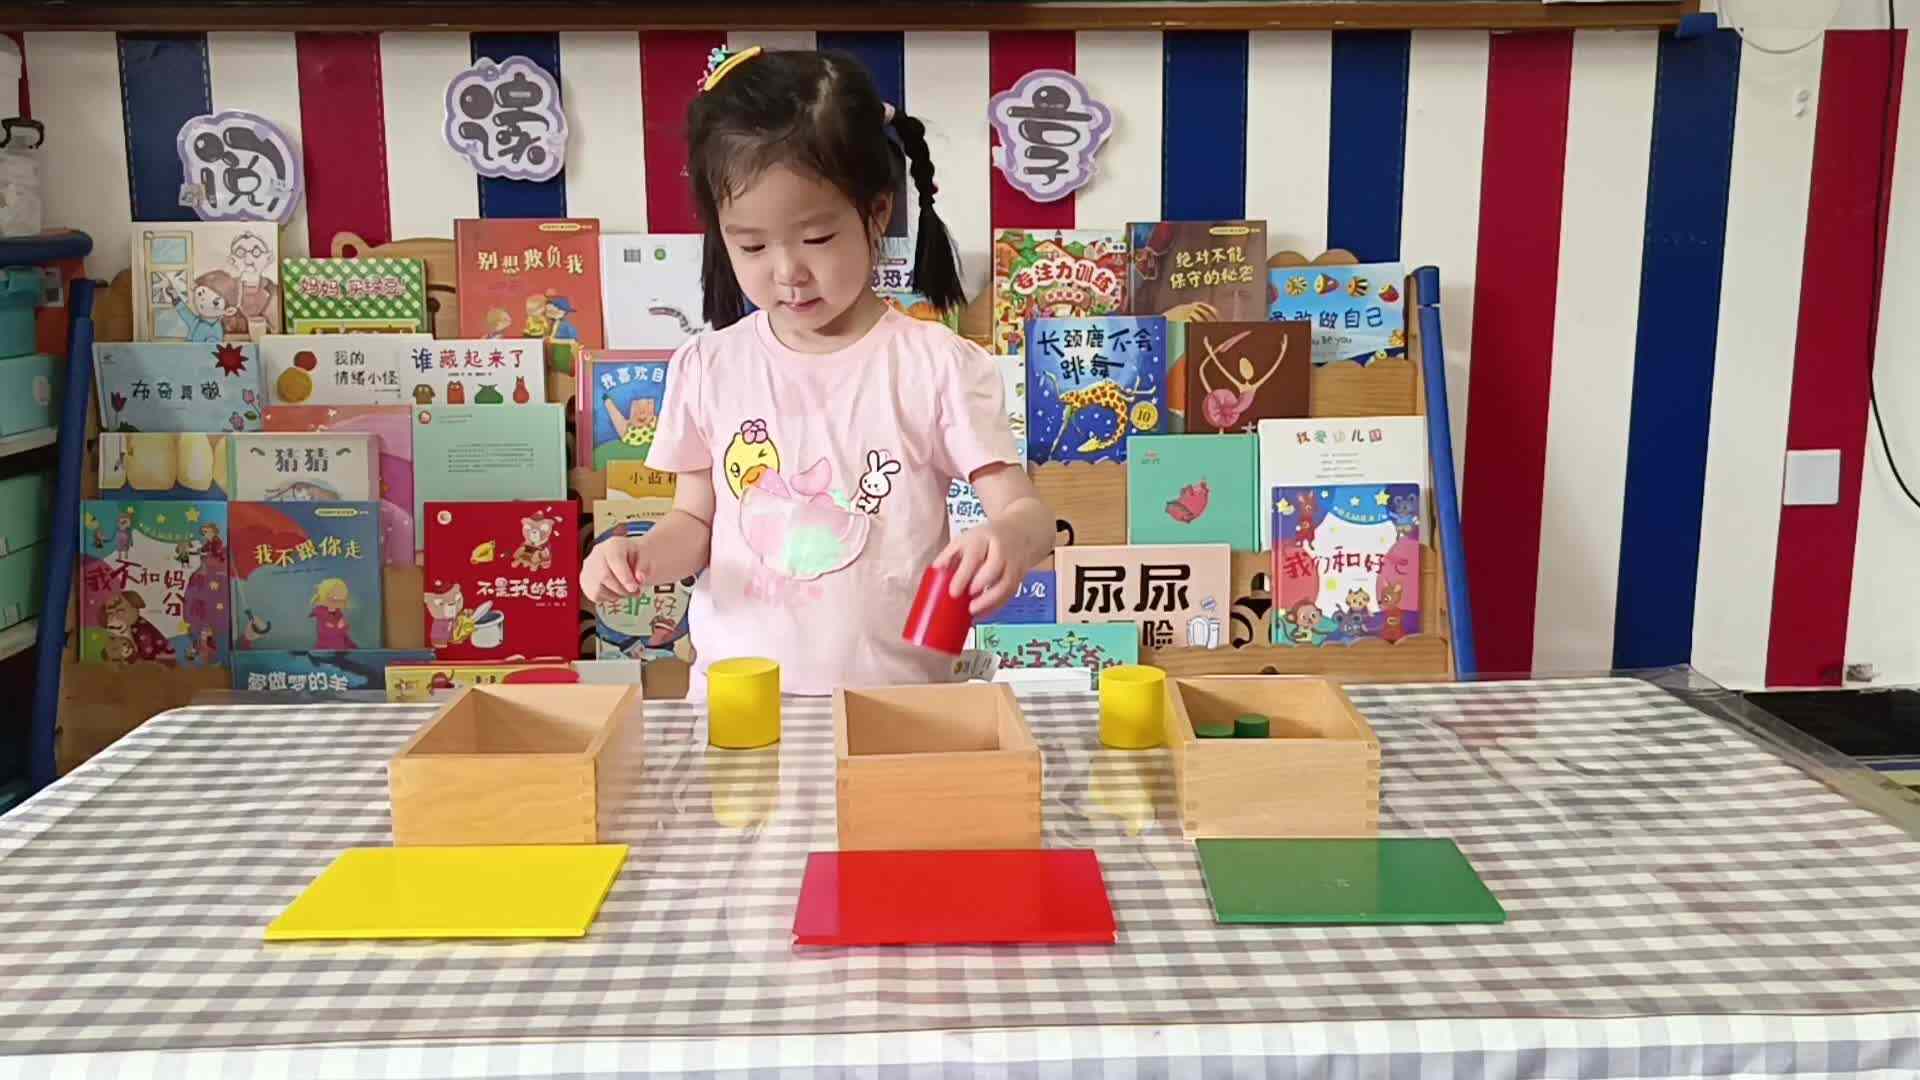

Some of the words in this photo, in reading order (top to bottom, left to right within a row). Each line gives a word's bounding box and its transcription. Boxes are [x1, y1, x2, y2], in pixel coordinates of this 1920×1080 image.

[459, 71, 549, 165] 读
[1007, 85, 1092, 186] 享
[194, 127, 286, 212] 阅
[477, 246, 584, 276] 别想欺负我
[1175, 246, 1246, 267] 绝对不能
[1037, 325, 1153, 358] 长颈鹿不会
[411, 348, 525, 373] 谁藏起来了
[1060, 354, 1125, 385] 跳舞
[275, 448, 329, 473] 猜猜
[255, 535, 364, 567] 我不跟你走
[1068, 563, 1191, 614] 尿尿
